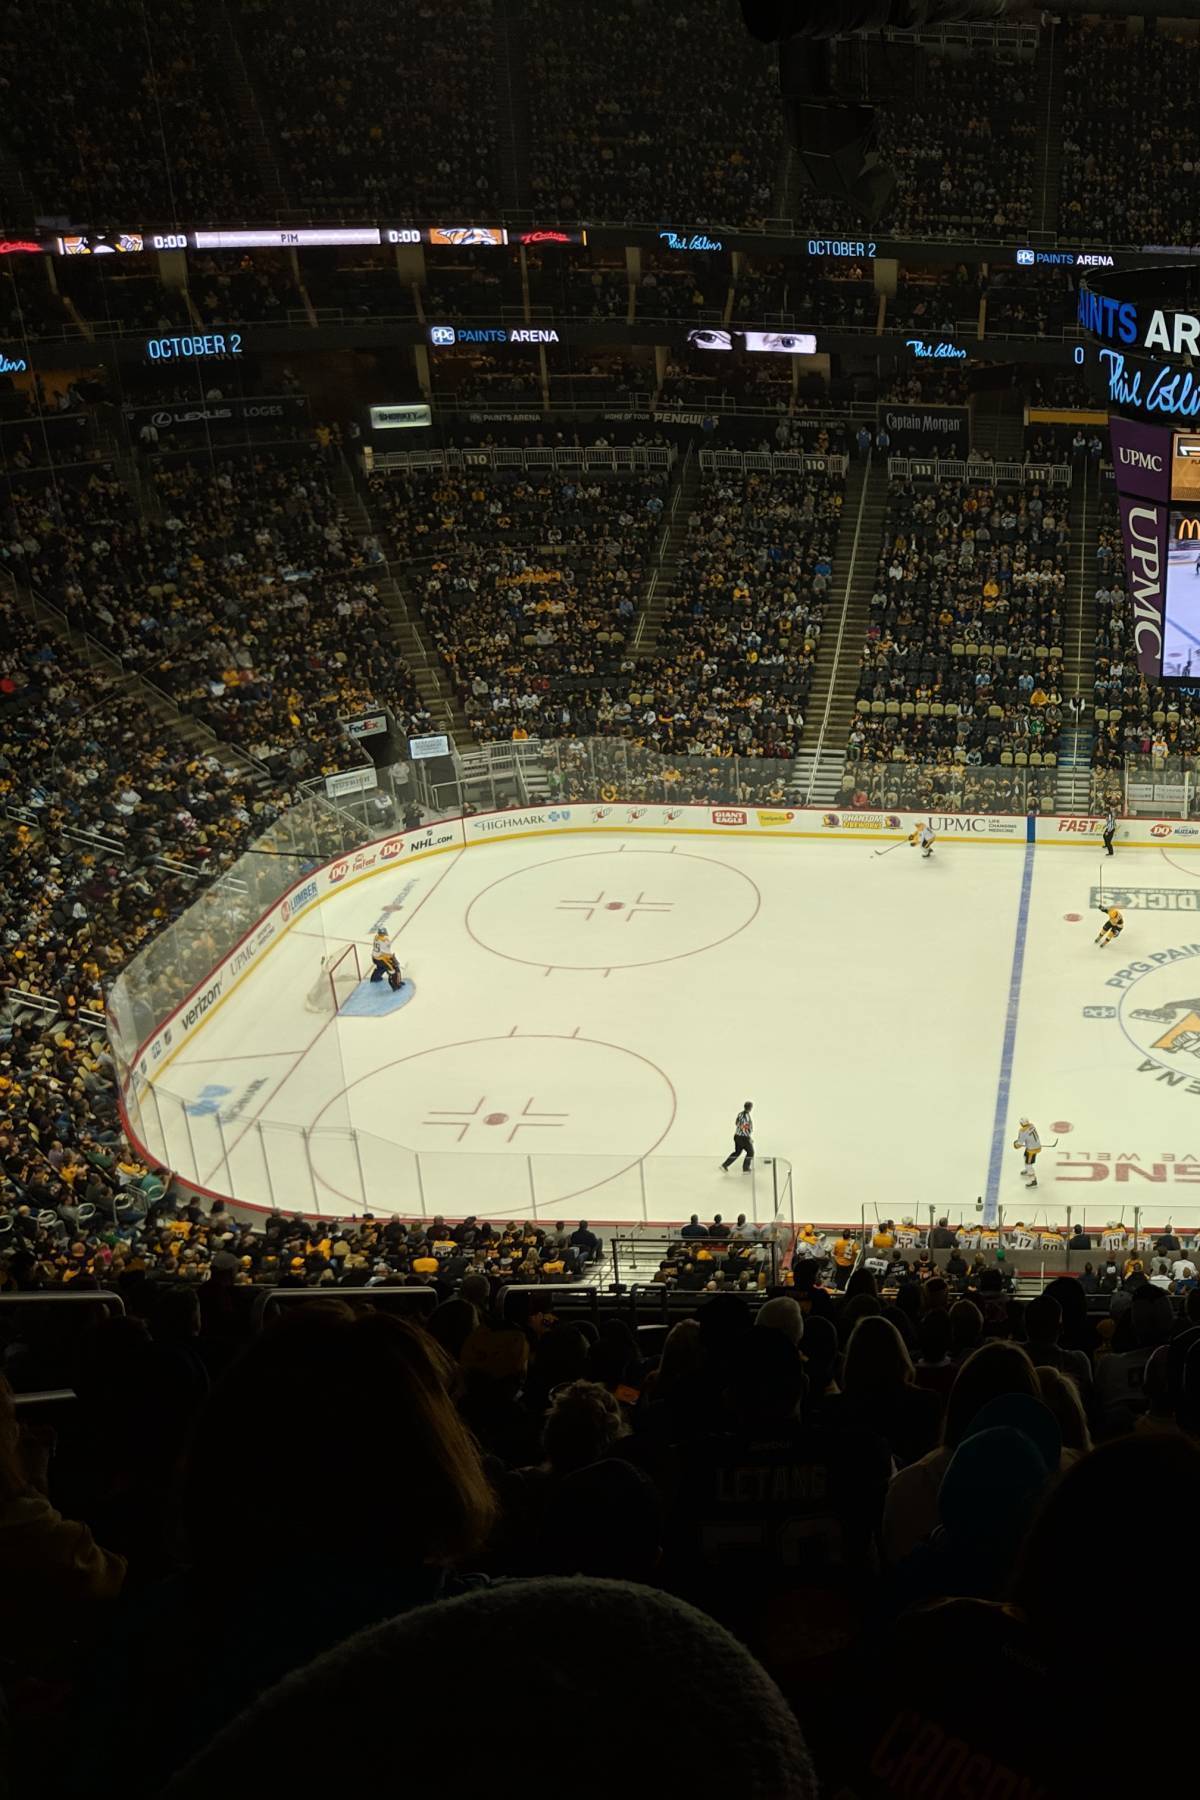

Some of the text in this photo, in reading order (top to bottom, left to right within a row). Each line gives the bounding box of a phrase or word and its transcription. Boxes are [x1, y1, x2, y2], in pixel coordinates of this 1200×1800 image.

[154, 235, 187, 249] 0:00
[281, 233, 298, 245] PIM
[389, 230, 420, 244] 0:00
[659, 232, 722, 251] Phil Collins
[808, 241, 877, 258] OCTOBER 2
[1017, 250, 1114, 267] PPG PAINTS ARENA
[1077, 288, 1138, 344] AINTS
[431, 327, 559, 345] PPG PAINTS ARENA
[148, 334, 243, 359] OCTOBER 2
[906, 340, 966, 358] Phil Collins
[1099, 349, 1142, 408] Phil
[174, 406, 283, 423] LEXUS LOGES
[654, 413, 720, 426] PENGUIS
[886, 412, 960, 433] Captain Morgan
[467, 455, 487, 465] 110
[806, 461, 825, 471] 110
[1119, 447, 1163, 472] UPMC
[1128, 508, 1163, 660] UPMC
[481, 815, 545, 831] HIGHMARK
[842, 814, 882, 822] PHANTOM
[928, 817, 986, 833] UPMC
[1059, 820, 1098, 832] FAST
[381, 843, 401, 857] DQ
[411, 835, 453, 852] NHL.COM
[331, 861, 349, 877] DQ
[291, 882, 318, 911] LUMBER
[229, 942, 258, 977] UPMC
[1104, 961, 1153, 990] PPG
[181, 981, 224, 1031] verizon
[1057, 1152, 1141, 1161] WELL
[1019, 1238, 1032, 1248] 17
[1109, 1238, 1121, 1250] 19
[713, 1465, 831, 1503] LETANG
